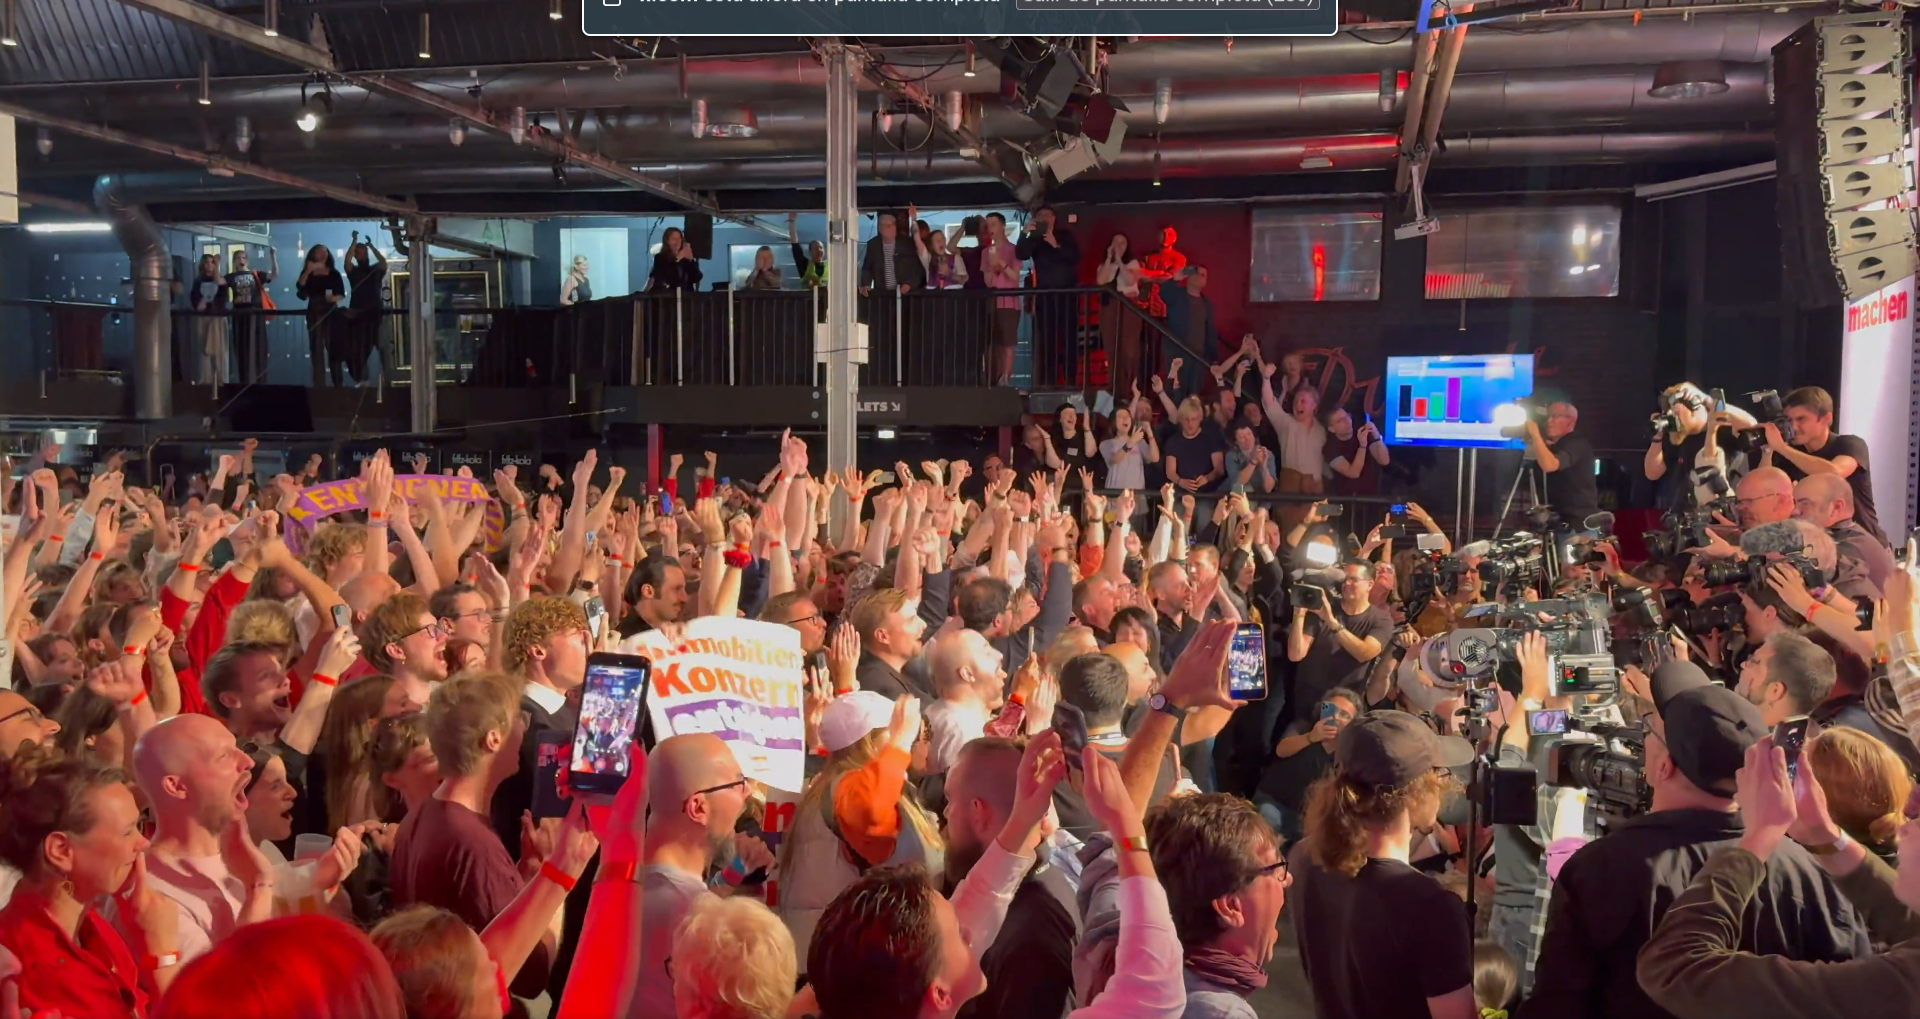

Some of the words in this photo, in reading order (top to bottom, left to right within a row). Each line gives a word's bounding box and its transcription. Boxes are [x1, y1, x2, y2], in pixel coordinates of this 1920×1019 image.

[1848, 287, 1908, 332] machen
[856, 401, 888, 412] LETS
[651, 662, 799, 708] Konzern
